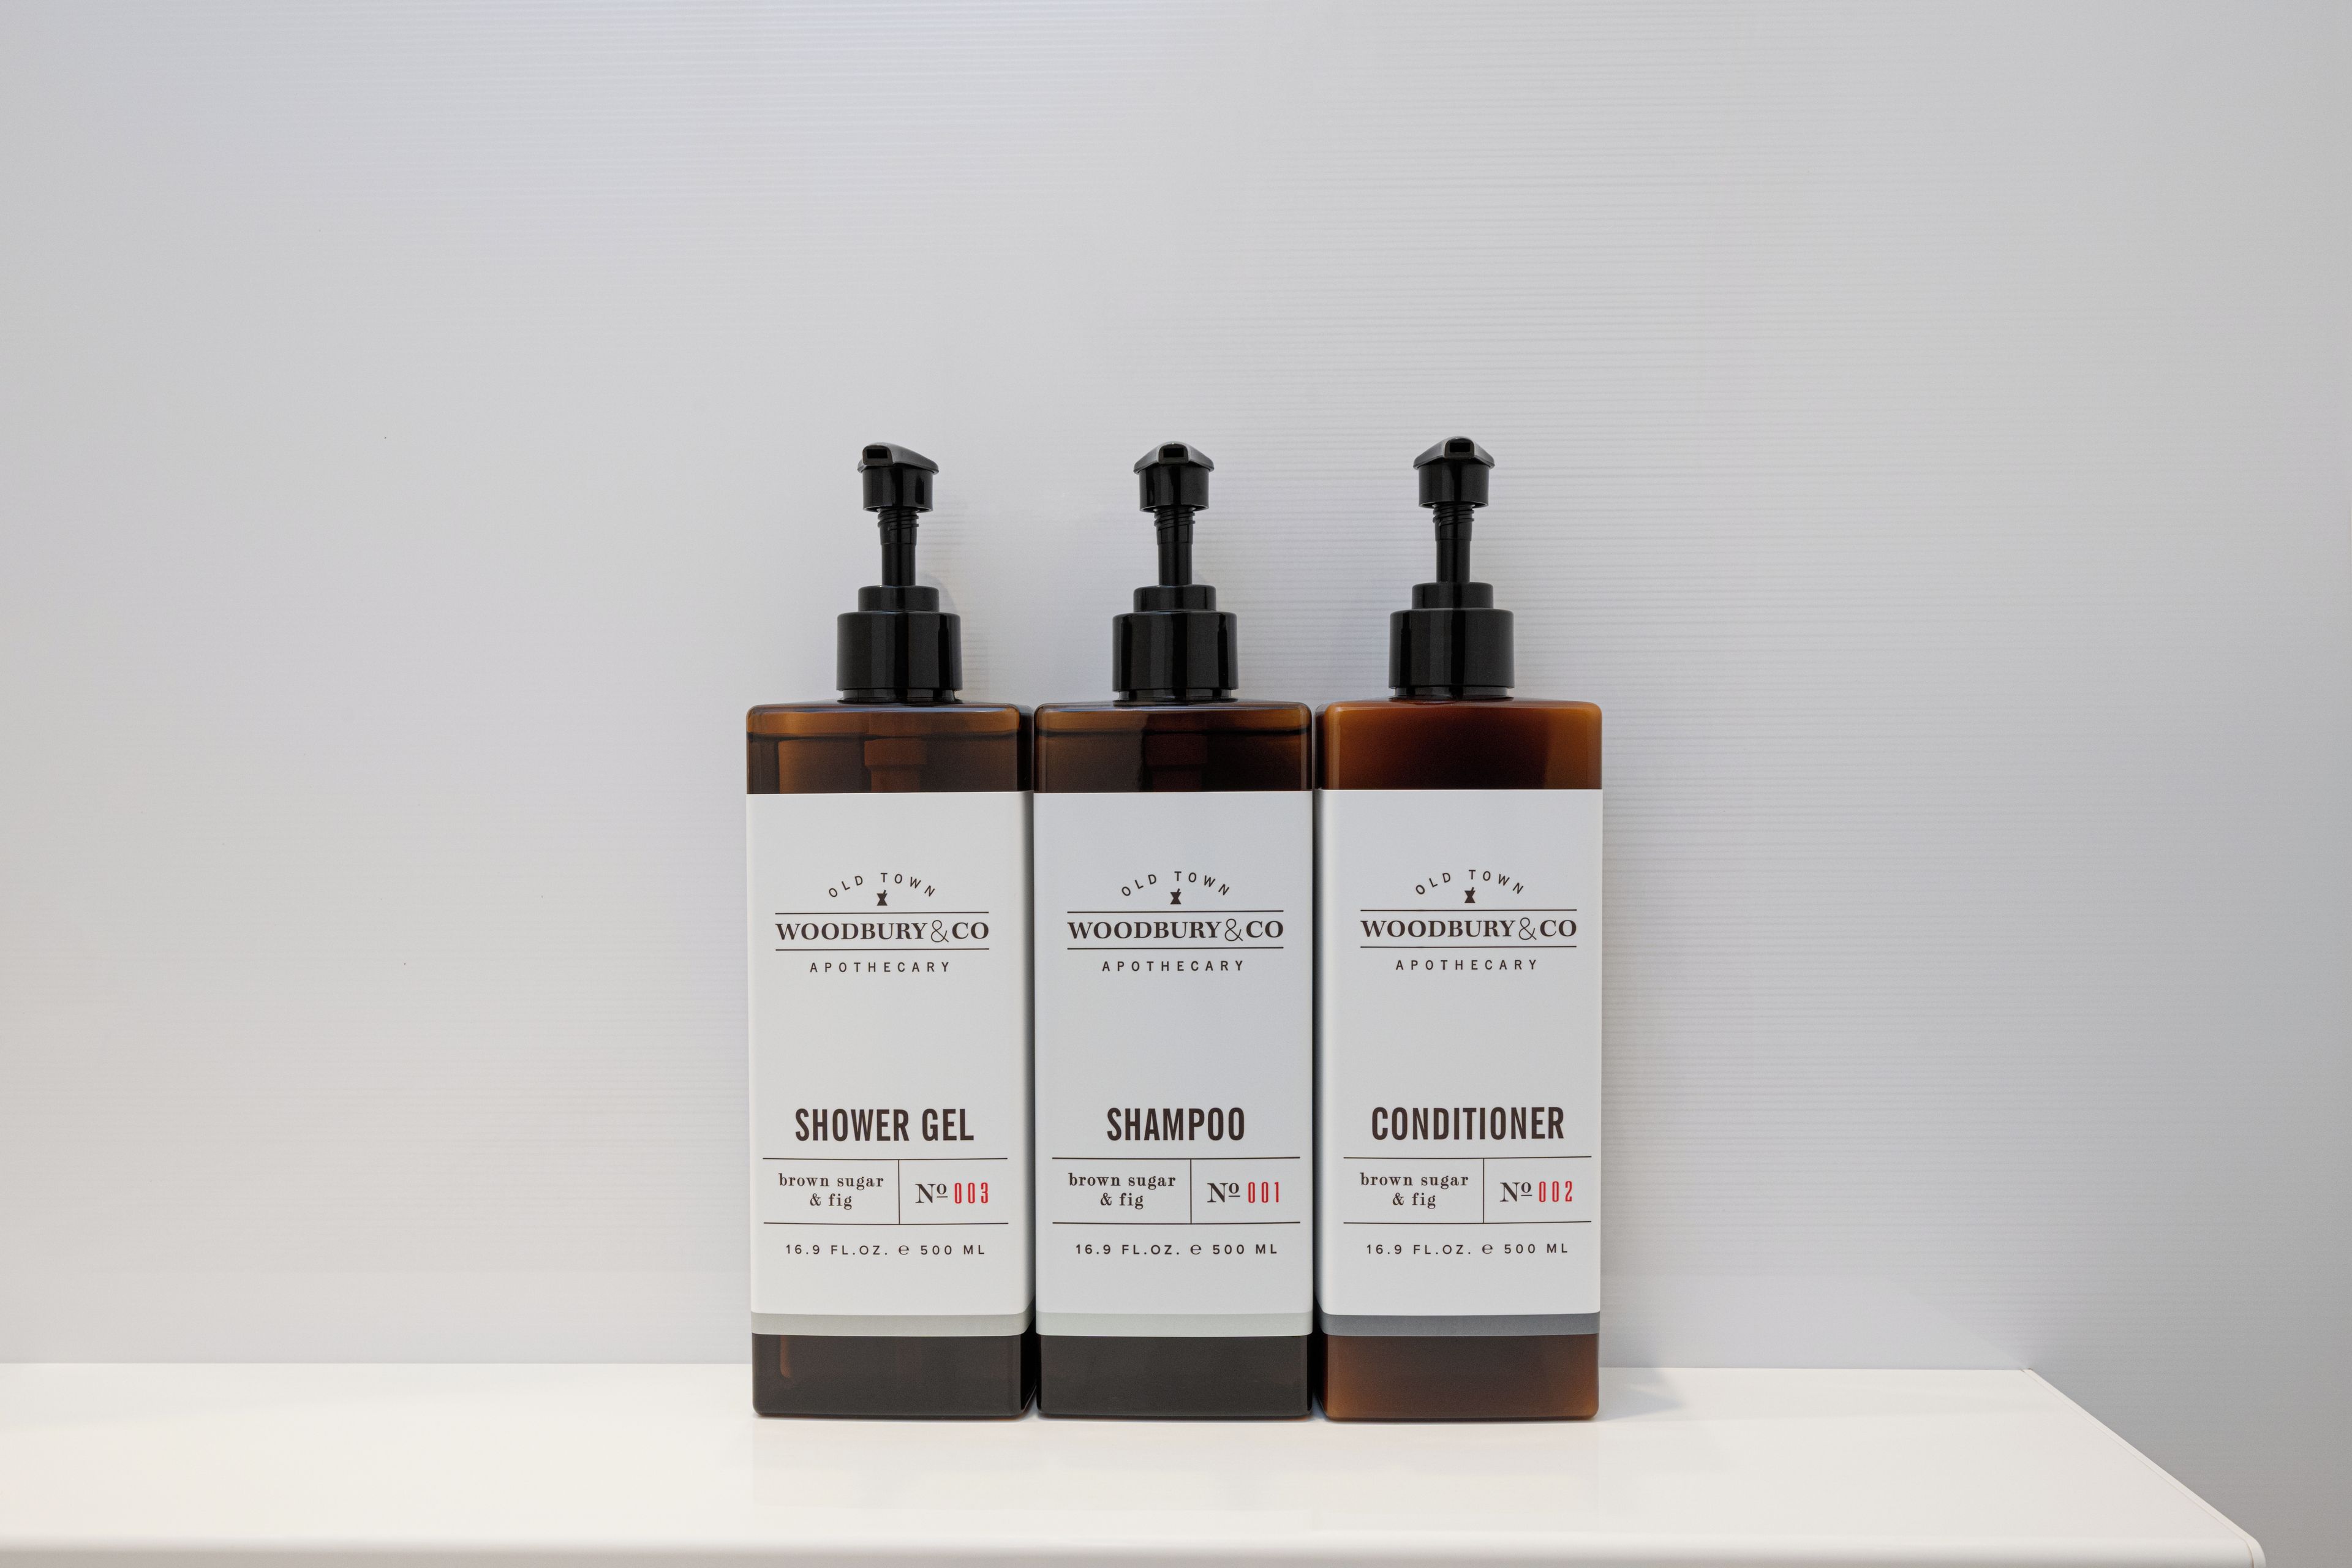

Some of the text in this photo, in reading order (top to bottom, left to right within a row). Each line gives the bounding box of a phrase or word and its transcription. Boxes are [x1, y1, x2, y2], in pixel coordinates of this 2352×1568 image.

[829, 873, 935, 898] OLD TOWN
[1122, 871, 1230, 897] OLD TOWN
[1415, 869, 1524, 895] OLD TOWN
[810, 962, 949, 973] APOTHECARY
[1102, 960, 1243, 971] APOTHECARY
[1395, 959, 1537, 971] APOTHECARY
[795, 1108, 974, 1142] SHOWER GEL
[1107, 1107, 1245, 1141] SHAMPOO
[1371, 1106, 1564, 1140] CONDITIONER
[778, 1173, 884, 1191] brown sugar
[1068, 1172, 1176, 1191] brown sugar
[1359, 1172, 1469, 1189] brown sugar
[954, 1182, 989, 1204] 003
[1248, 1182, 1280, 1204] 001
[1539, 1180, 1573, 1203] 002
[810, 1193, 852, 1210] & fig
[1100, 1192, 1144, 1210] & fig
[1392, 1192, 1436, 1210] & fig
[786, 1244, 820, 1255] 16.9
[921, 1245, 952, 1255] 500
[963, 1245, 985, 1255] ML
[1076, 1244, 1111, 1255] 16.9
[1213, 1244, 1245, 1255] 500
[1256, 1243, 1277, 1254] ML
[1366, 1244, 1402, 1254] 16.9
[1504, 1243, 1536, 1254] 500
[1547, 1243, 1568, 1254] ML
